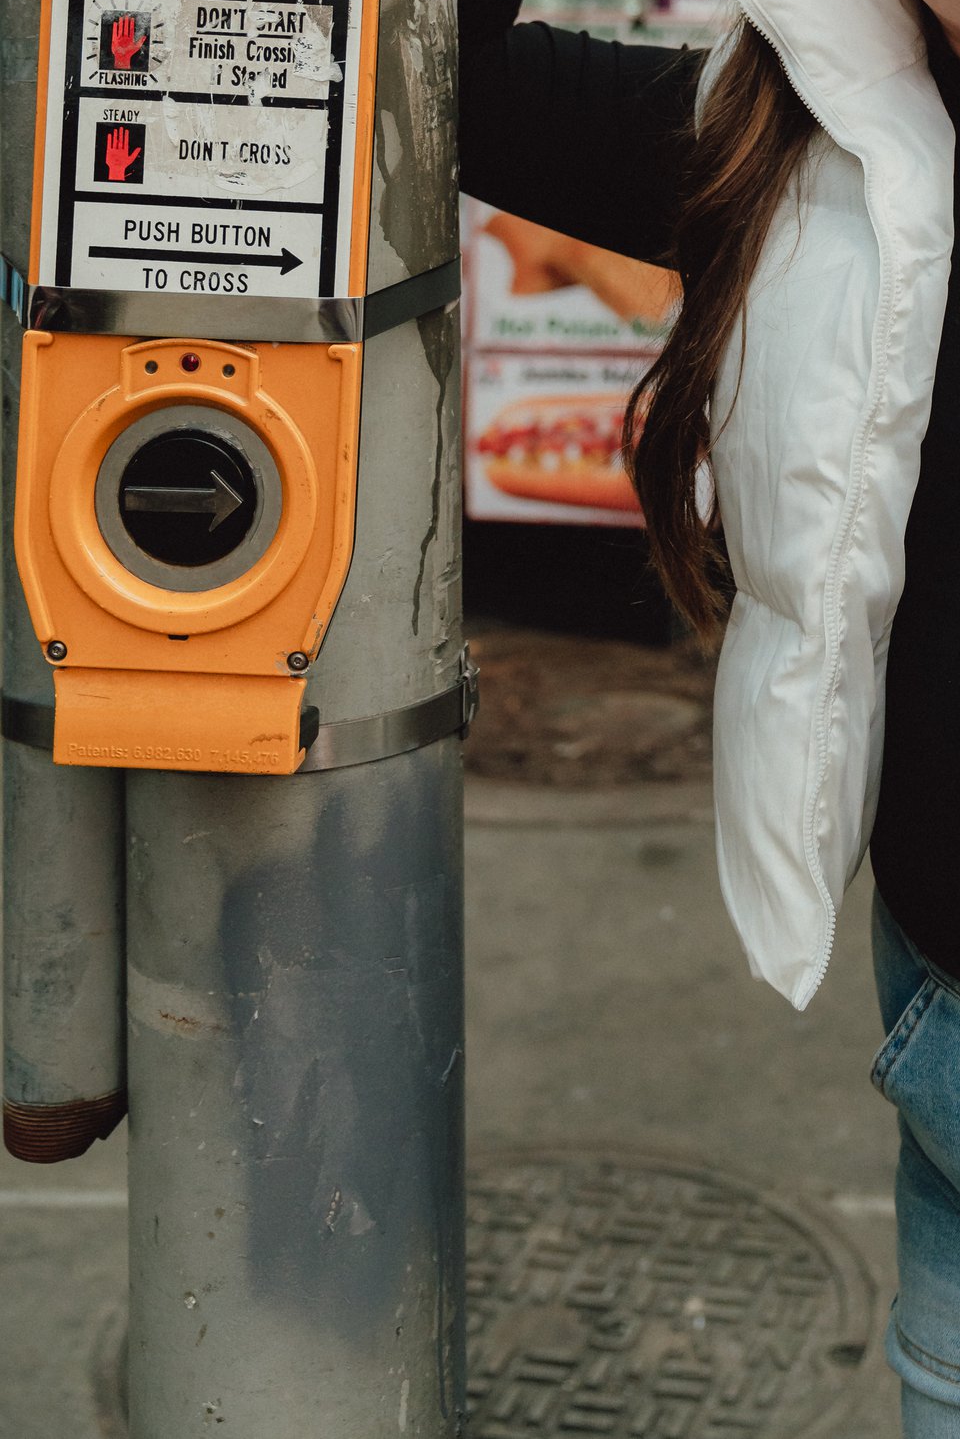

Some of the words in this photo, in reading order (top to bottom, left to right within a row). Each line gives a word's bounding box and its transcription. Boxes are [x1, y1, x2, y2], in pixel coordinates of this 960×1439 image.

[196, 7, 246, 31] DON'T
[188, 36, 235, 60] Finish
[246, 40, 295, 63] Crossi
[98, 71, 148, 87] FLASHING
[231, 65, 288, 89] Staed
[102, 108, 140, 122] STEADY
[178, 139, 229, 161] DONT
[239, 142, 292, 165] CROSS
[123, 219, 181, 242] PUSH
[190, 222, 272, 247] BUTTON
[142, 268, 168, 290] TO
[179, 270, 249, 294] CROSS
[67, 743, 129, 759] Patents:
